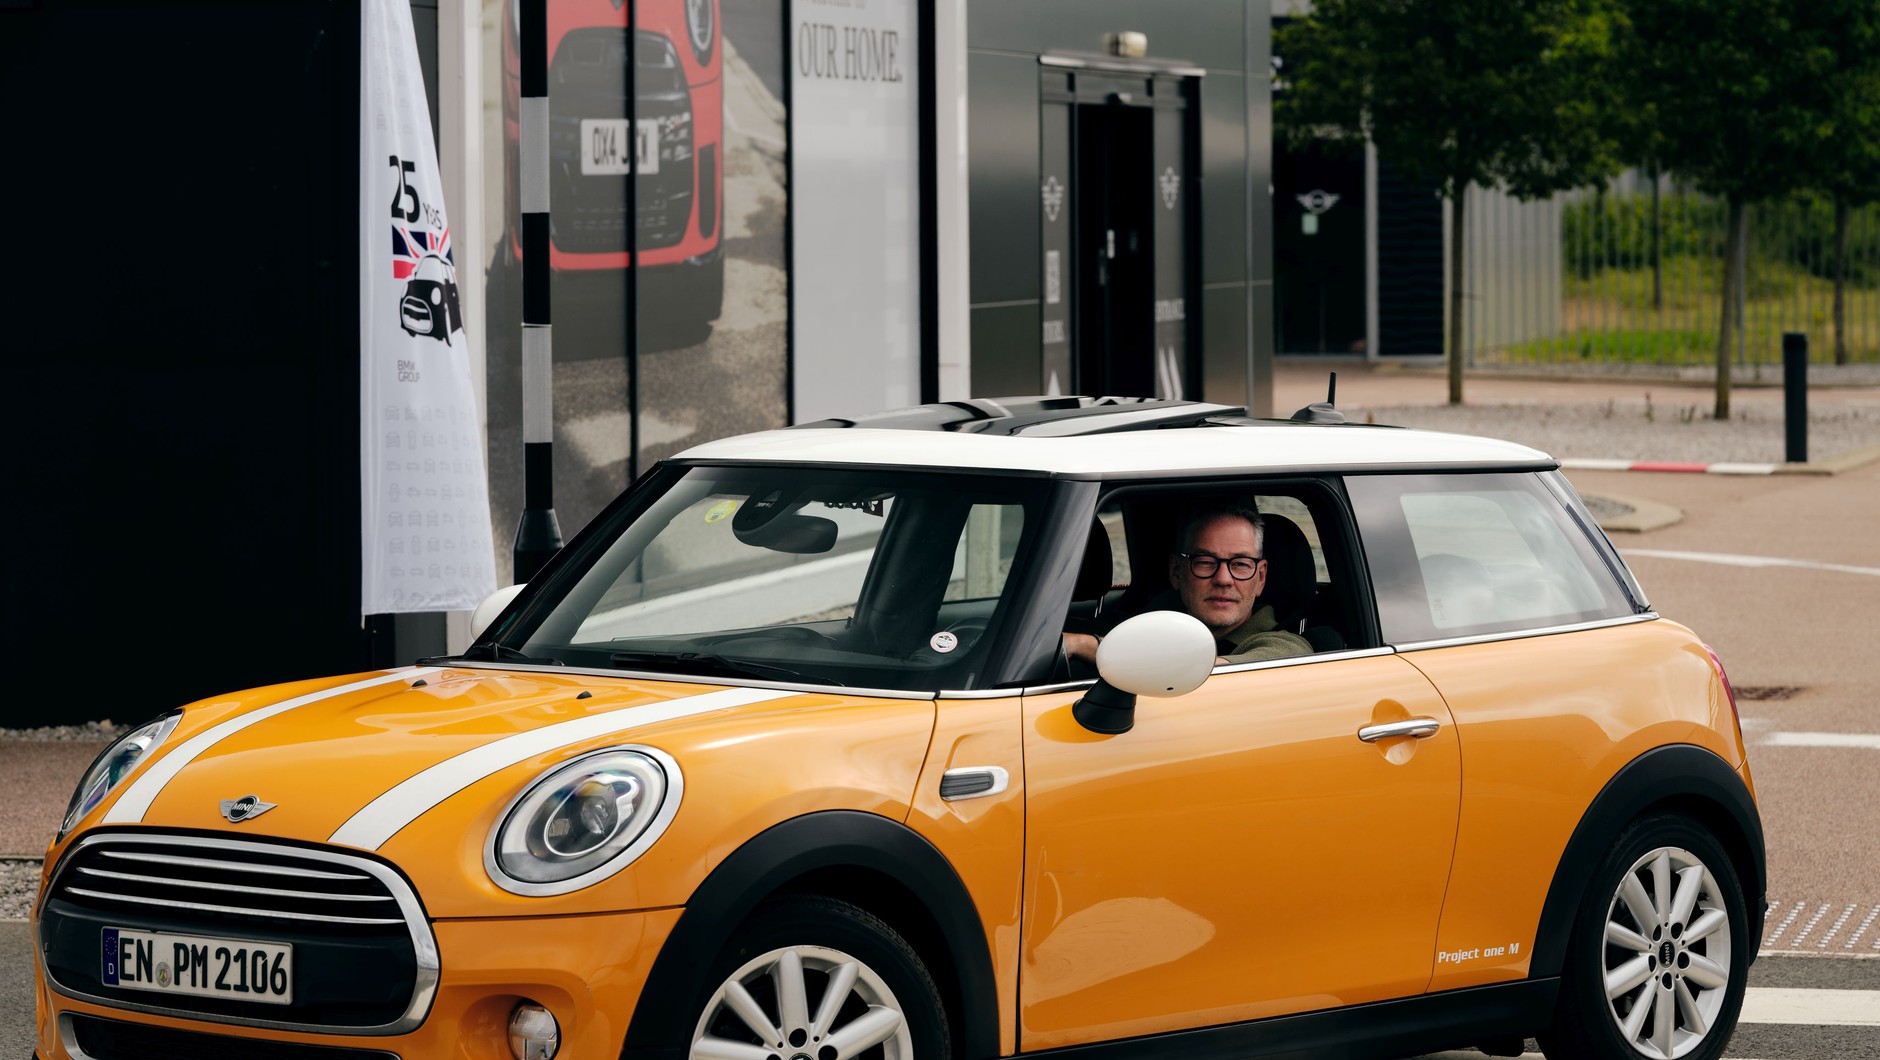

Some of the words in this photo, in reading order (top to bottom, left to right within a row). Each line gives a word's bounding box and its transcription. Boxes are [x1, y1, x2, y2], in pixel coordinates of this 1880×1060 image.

[799, 22, 838, 78] OUR
[844, 26, 902, 82] HOME.
[593, 127, 617, 166] OX4
[621, 126, 649, 166] JW
[389, 154, 420, 223] 25
[397, 359, 415, 371] BMW
[231, 802, 254, 811] MINI
[108, 962, 115, 975] D
[119, 937, 153, 983] EN
[173, 942, 208, 989] PM
[214, 947, 287, 996] 2106
[1438, 947, 1479, 964] Project
[1484, 946, 1504, 957] one
[1508, 942, 1520, 955] M
